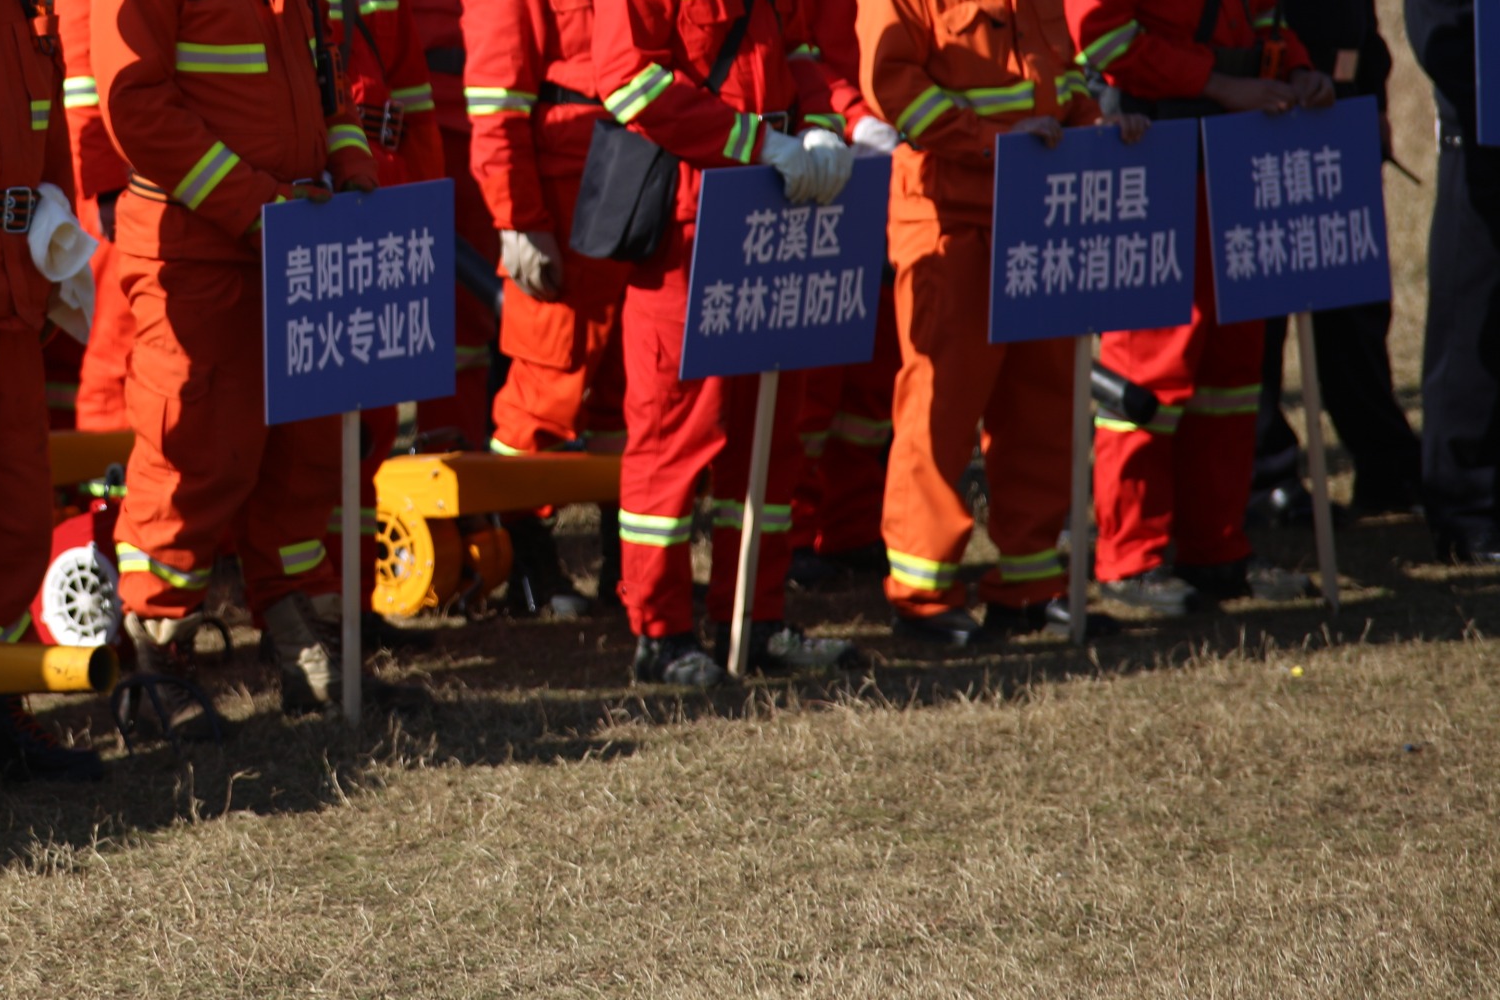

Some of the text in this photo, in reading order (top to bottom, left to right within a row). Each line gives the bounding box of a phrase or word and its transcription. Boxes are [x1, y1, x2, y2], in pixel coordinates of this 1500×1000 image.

[1044, 166, 1149, 227] 开阳县
[1252, 145, 1342, 210] 清镇市
[286, 227, 435, 305] 贵阳市森林
[743, 205, 844, 265] 花溪区
[1005, 229, 1182, 299] 森林消防队
[1225, 206, 1379, 281] 森林消防队
[699, 267, 866, 336] 森林消防队
[287, 297, 436, 376] 防火专业队
